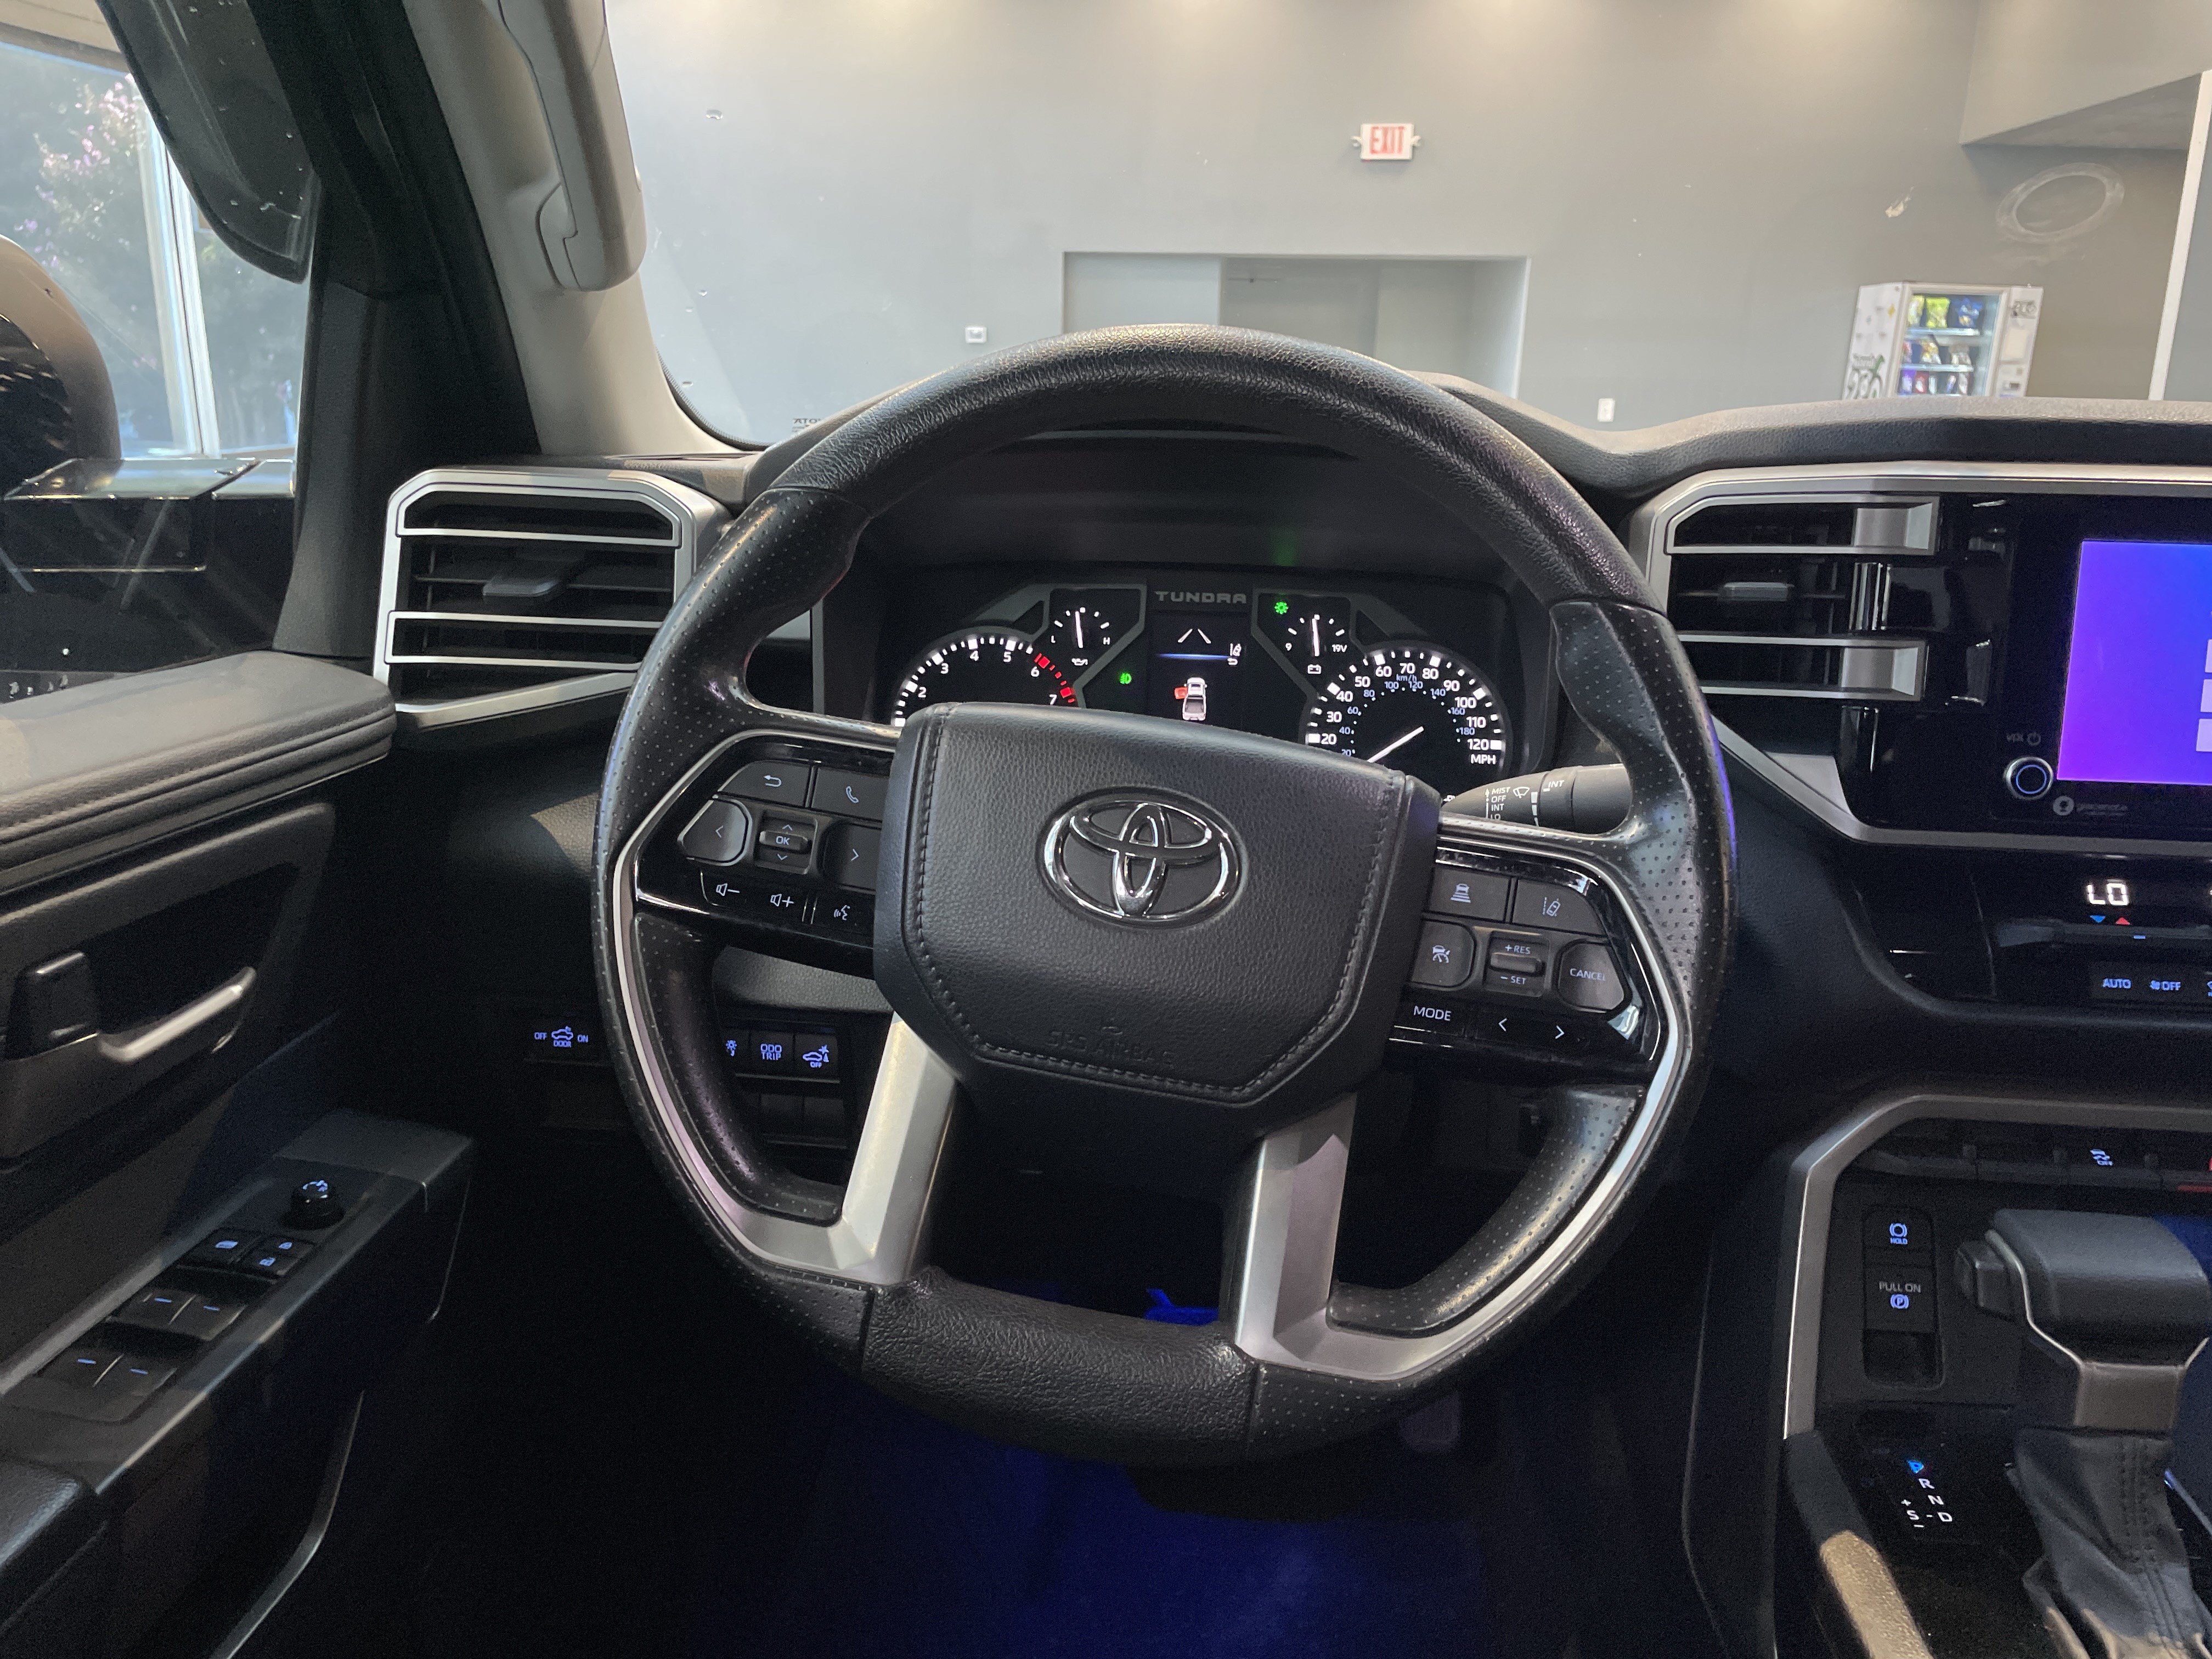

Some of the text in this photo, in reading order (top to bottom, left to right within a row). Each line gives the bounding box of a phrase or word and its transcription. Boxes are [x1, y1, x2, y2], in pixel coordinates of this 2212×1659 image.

[1369, 126, 1405, 154] EXIT
[1154, 591, 1246, 603] TUNDRA
[1285, 642, 1292, 651] 9
[1331, 644, 1347, 652] 19V
[969, 650, 979, 661] 4
[1003, 651, 1012, 662] 5
[940, 662, 949, 674] 3
[1030, 665, 1040, 678] 6
[1375, 665, 1392, 678] 60
[1400, 663, 1415, 674] 70
[1396, 674, 1417, 682] km/h
[1422, 668, 1439, 680] 80
[1355, 676, 1371, 687] 50
[1384, 681, 1399, 690] 100
[1408, 681, 1424, 689] 120
[1443, 680, 1460, 692] 90
[918, 686, 927, 698] 2
[1336, 691, 1353, 702] 40
[1430, 688, 1446, 697] 140
[1049, 694, 1057, 706] 7
[1454, 696, 1477, 709] 100
[1347, 706, 1359, 714] 60
[1451, 707, 1465, 715] 160
[1327, 711, 1342, 723] 30
[1466, 716, 1487, 728] 110
[1339, 726, 1351, 735] 40
[1459, 727, 1475, 735] 180
[1321, 733, 1337, 745] 20
[1467, 738, 1489, 751] 120
[1470, 754, 1497, 765] MPH
[1548, 780, 1565, 788] INT
[1491, 787, 1511, 795] MIST
[1491, 803, 1504, 811] INT
[776, 836, 790, 846] OK
[2087, 883, 2129, 905] LO
[1570, 968, 1606, 981] CANCEL
[2103, 978, 2132, 989] AUTO
[2162, 981, 2181, 991] OFF
[1413, 1005, 1452, 1022] MODE
[534, 1032, 589, 1043] OFF ON
[760, 1043, 782, 1053] ODO
[761, 1052, 782, 1060] TRIP
[1879, 1281, 1921, 1293] PULL ON
[1918, 1478, 1935, 1489] R
[1927, 1495, 1944, 1505] N
[1906, 1510, 1920, 1520] S
[1937, 1511, 1953, 1522] D
